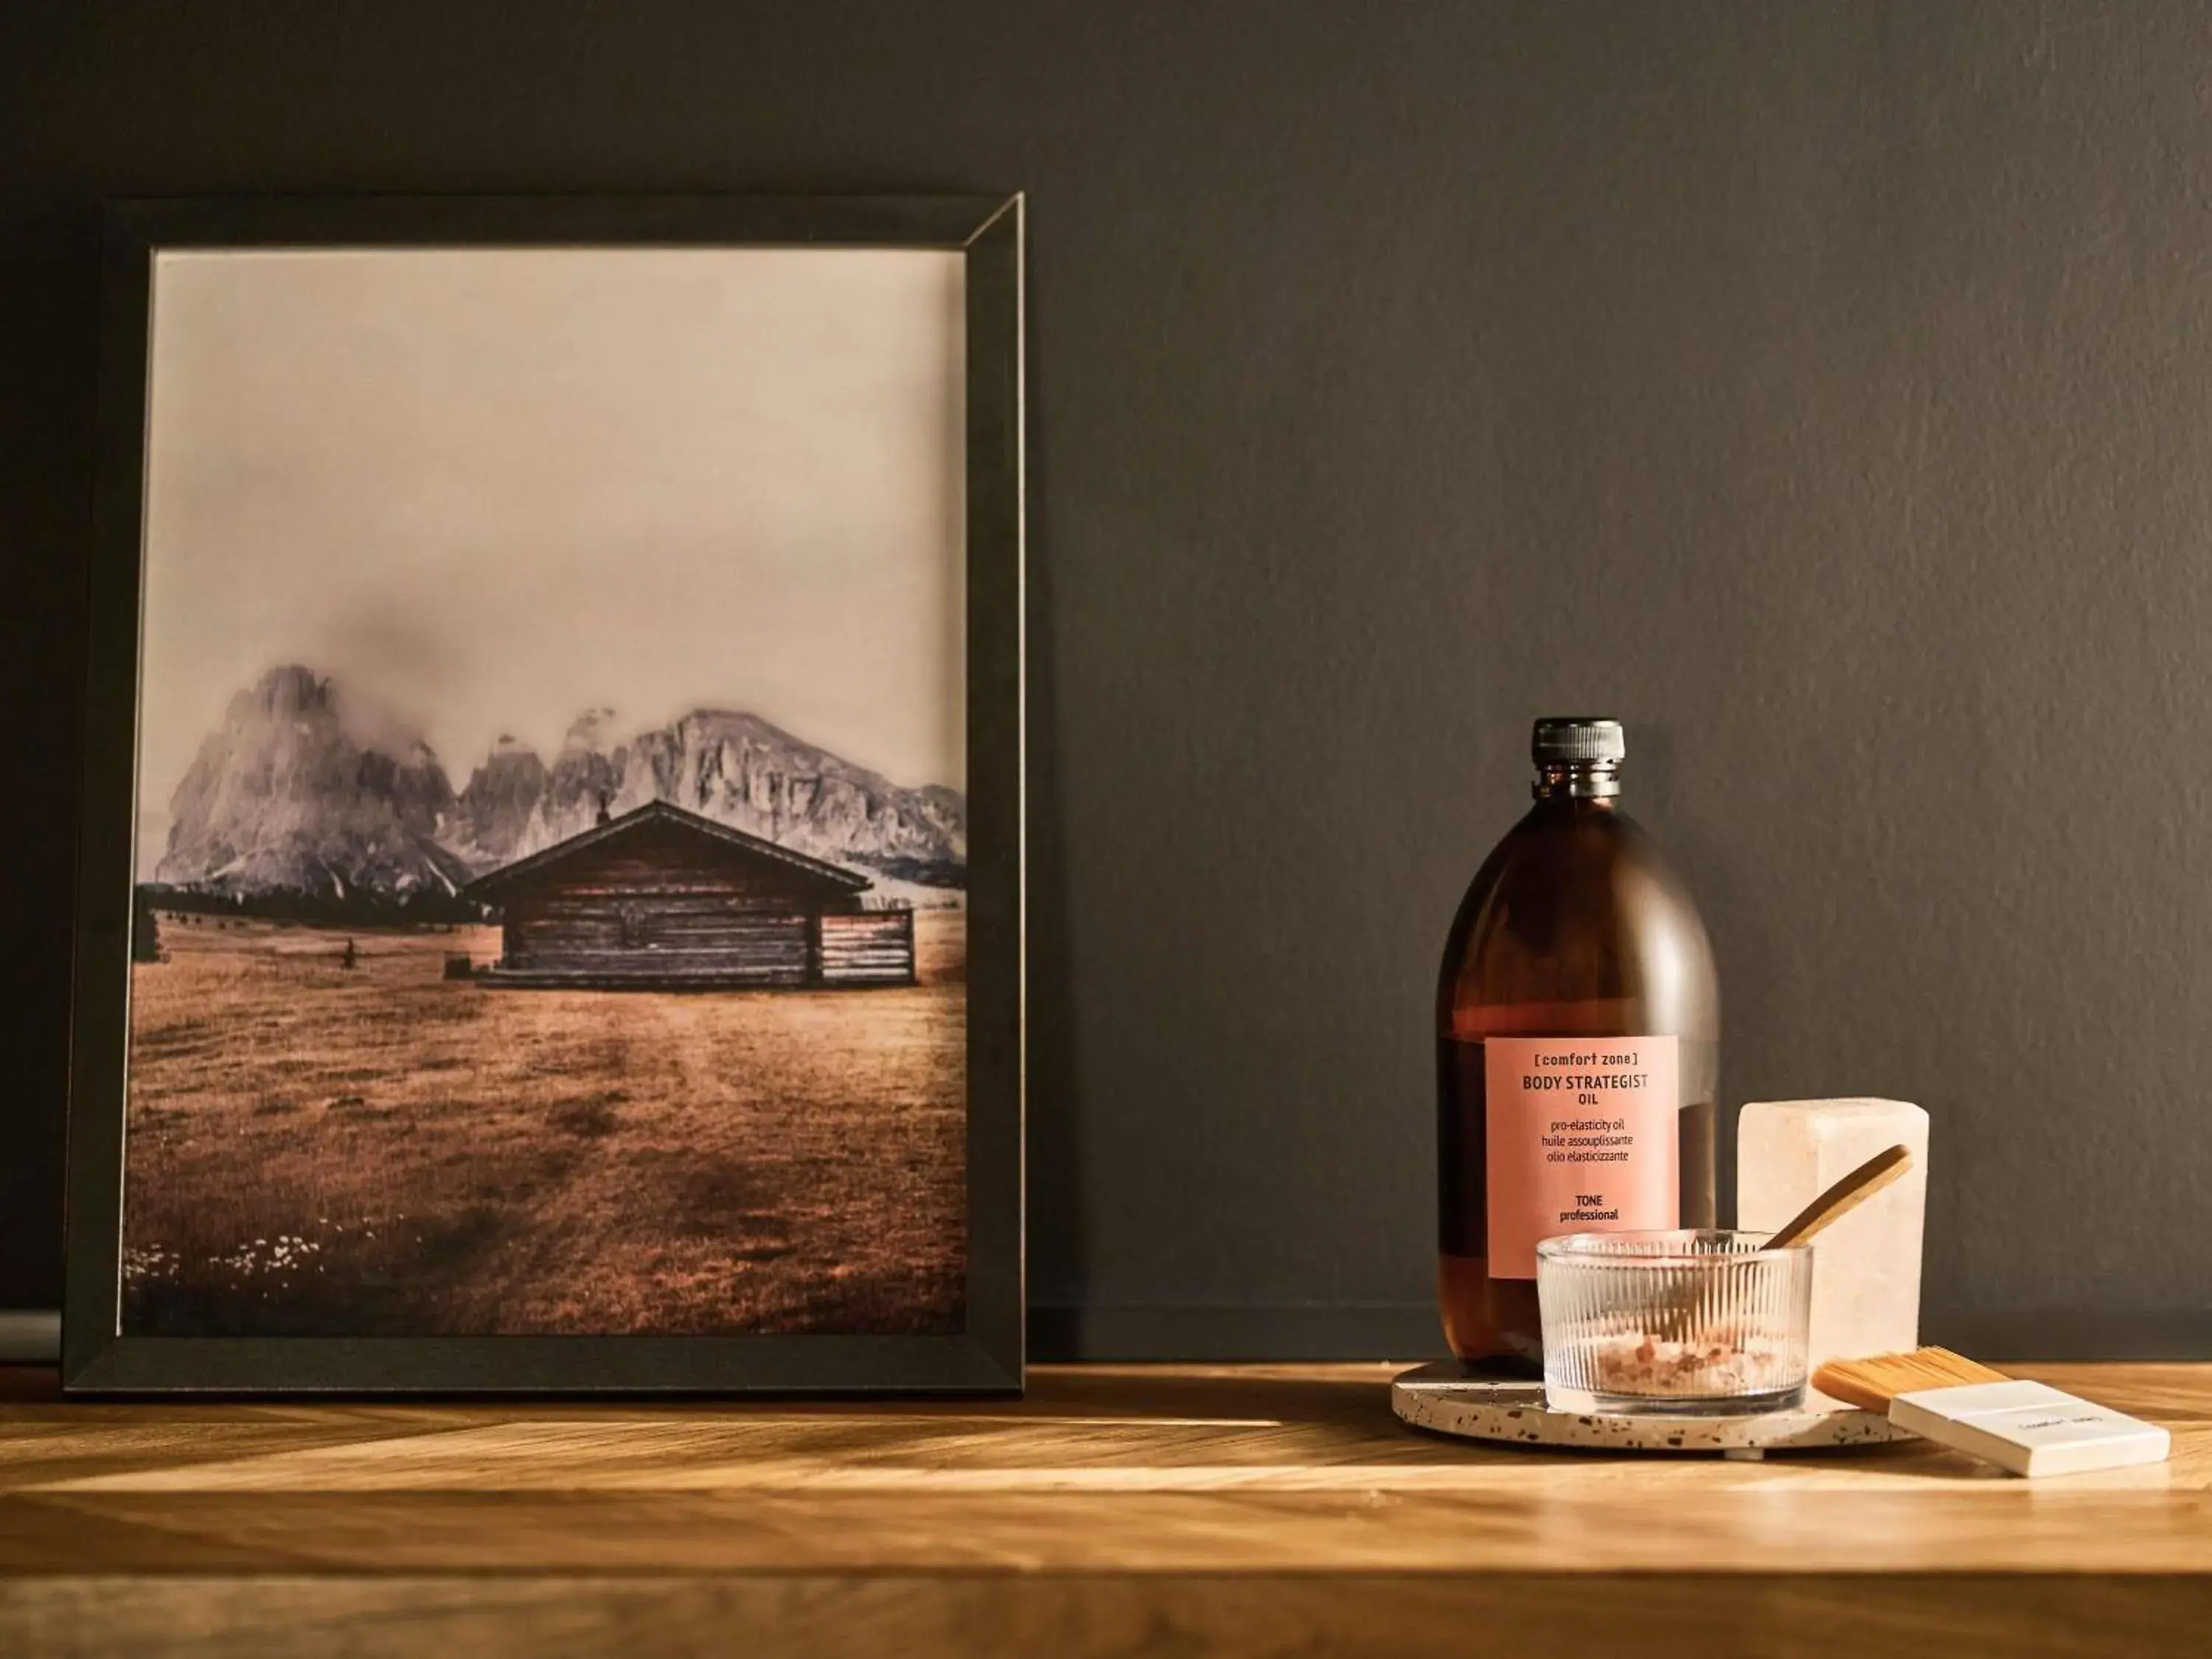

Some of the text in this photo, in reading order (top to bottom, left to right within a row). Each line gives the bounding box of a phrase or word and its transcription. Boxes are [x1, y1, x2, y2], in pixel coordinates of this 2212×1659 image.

[1523, 1074, 1648, 1090] BODY STRATEGIST
[1578, 1093, 1599, 1105] OIL
[1551, 1119, 1624, 1133] pro-elasticity oil
[1542, 1135, 1633, 1149] huile assouplissante
[1546, 1150, 1629, 1163] olio elasticizzante
[1575, 1194, 1603, 1206] TONE
[1559, 1208, 1618, 1222] professional
